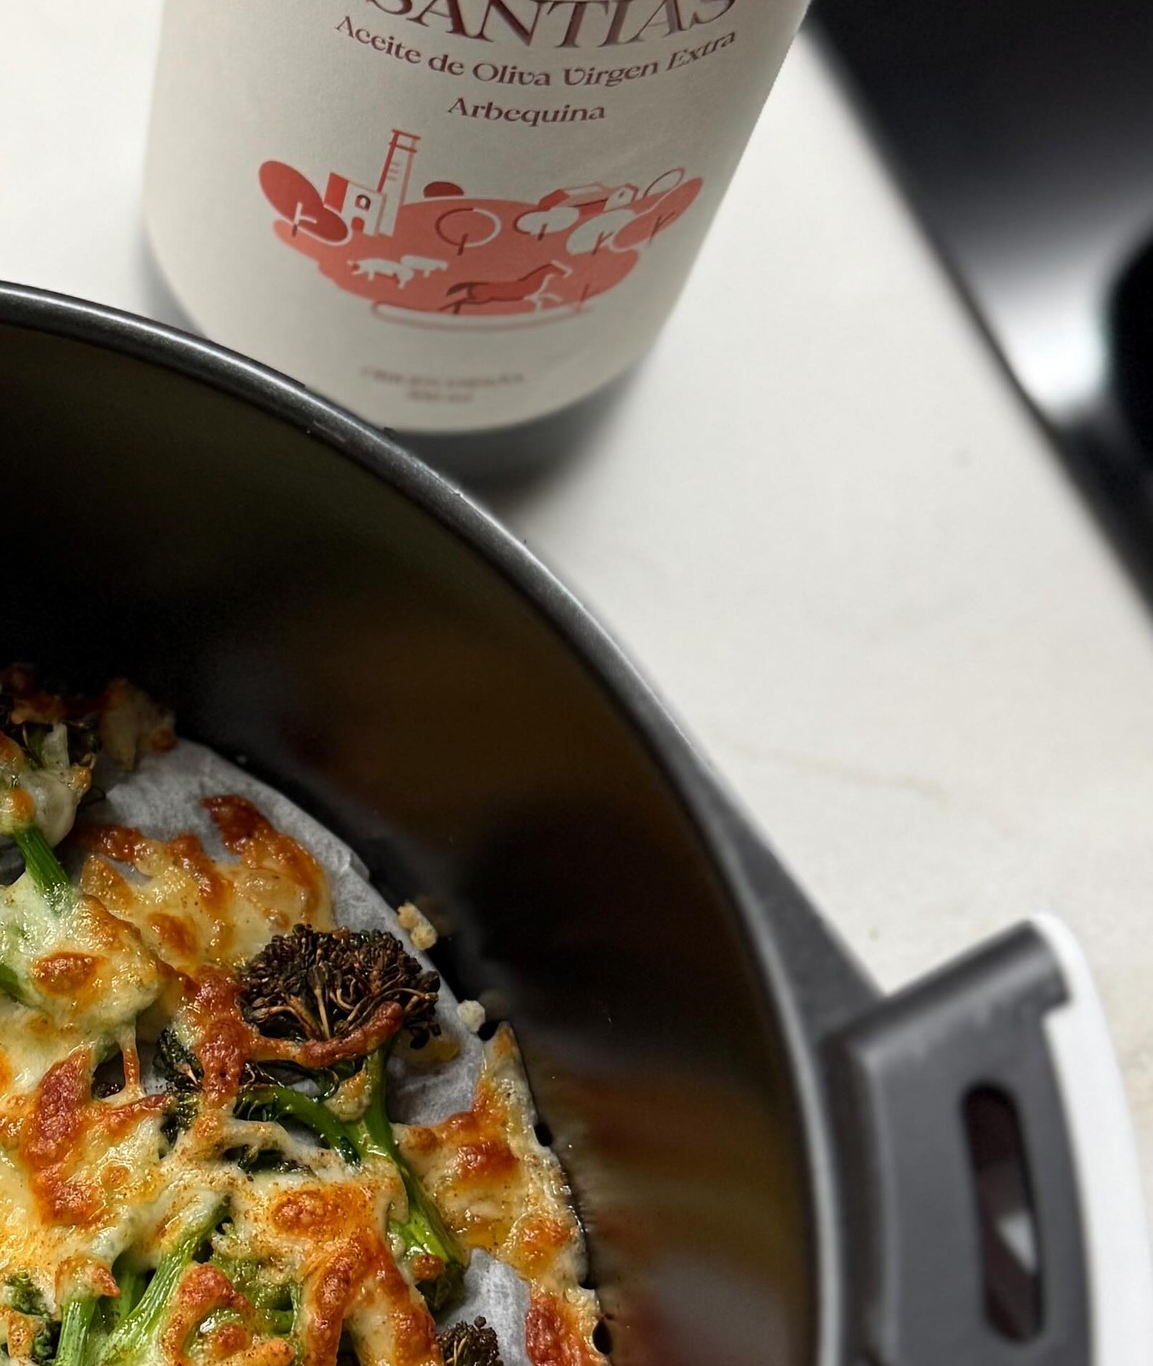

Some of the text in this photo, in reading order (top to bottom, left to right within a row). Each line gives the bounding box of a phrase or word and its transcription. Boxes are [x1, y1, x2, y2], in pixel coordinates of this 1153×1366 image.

[334, 15, 737, 88] Aceite de Oliva Virgen Extra
[447, 96, 607, 127] Arbequina
